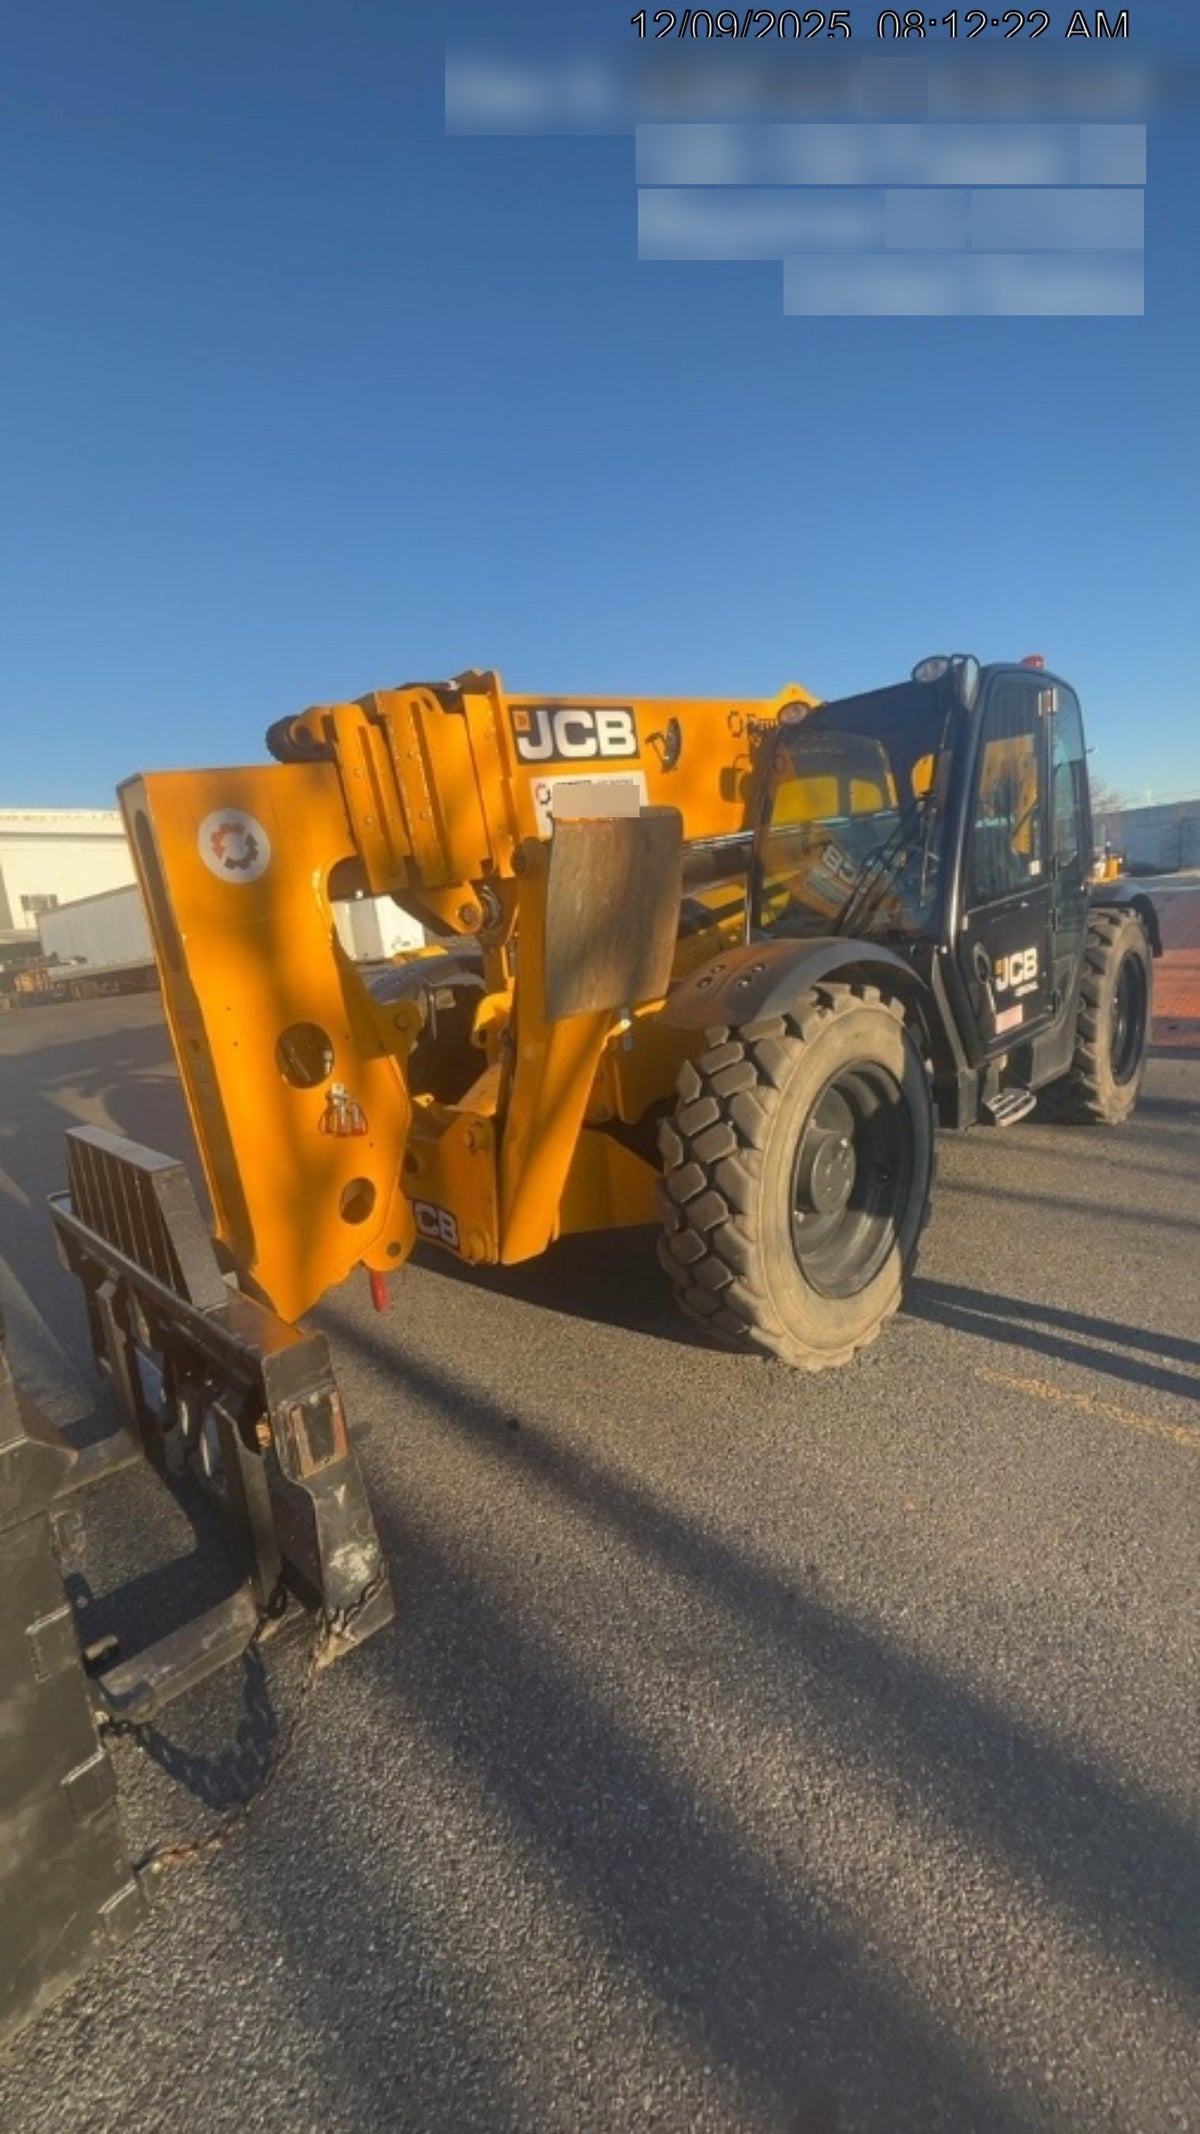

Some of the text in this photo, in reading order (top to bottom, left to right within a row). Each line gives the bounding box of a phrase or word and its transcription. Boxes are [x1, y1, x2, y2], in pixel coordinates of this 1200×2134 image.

[514, 709, 637, 760] JCB
[995, 947, 1038, 992] JCB
[414, 1201, 458, 1246] CB
